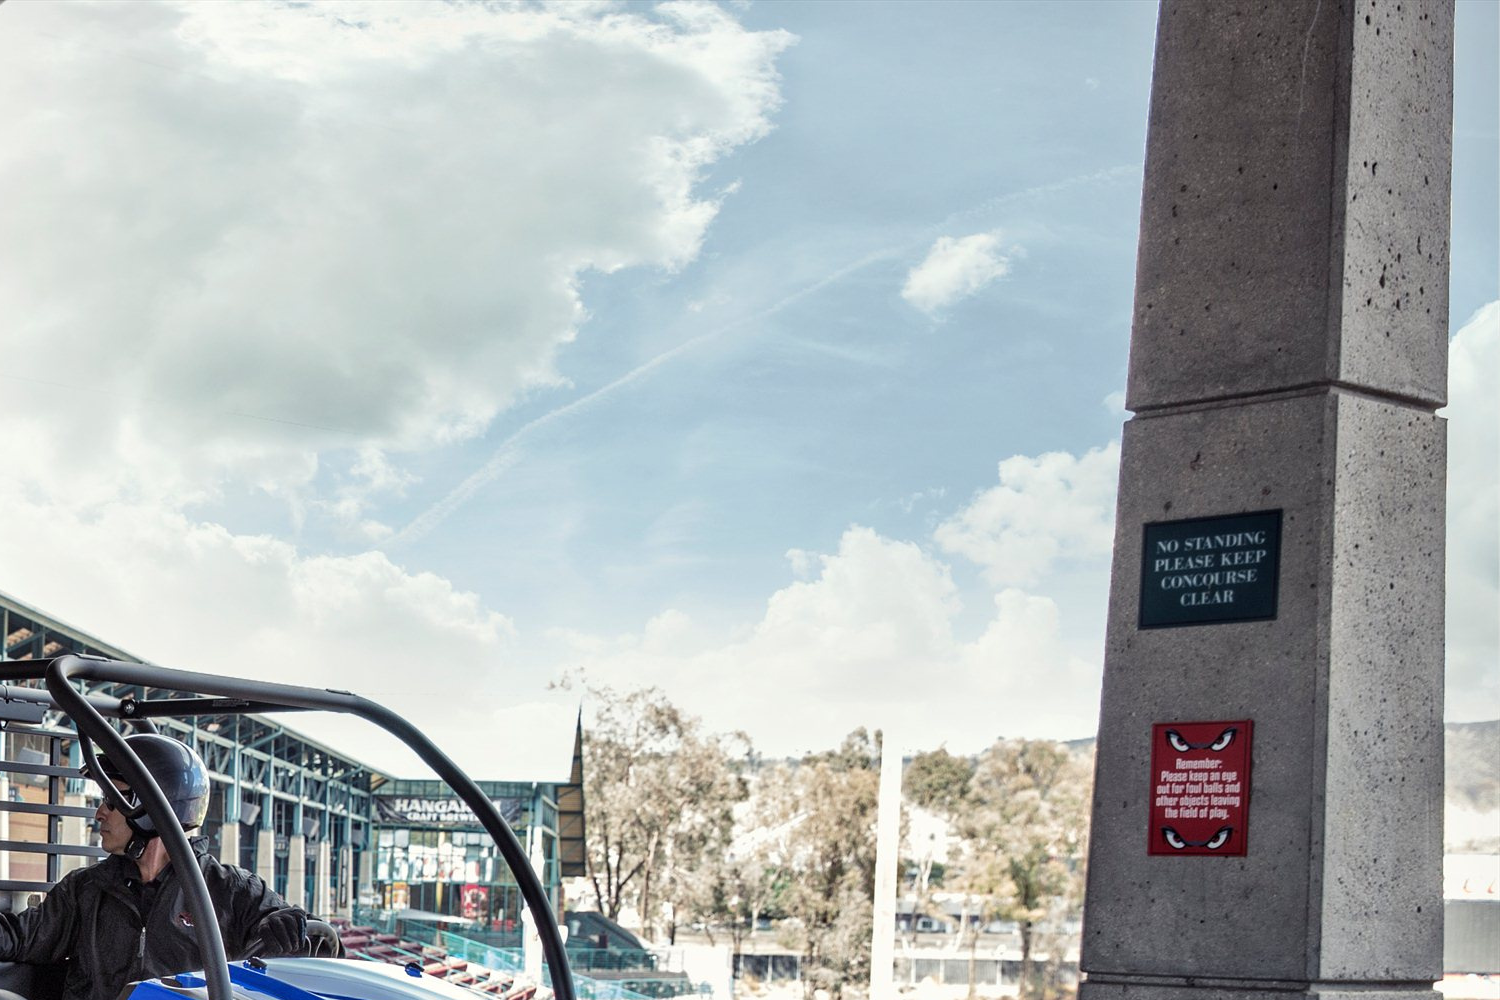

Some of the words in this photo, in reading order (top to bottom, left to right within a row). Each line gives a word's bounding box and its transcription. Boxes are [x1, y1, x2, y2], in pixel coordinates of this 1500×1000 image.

[1156, 540, 1179, 554] NO
[1184, 531, 1266, 551] STANDING
[1154, 554, 1215, 572] PLEASE
[1221, 549, 1267, 566] KEEP
[1161, 569, 1257, 589] CONCOURSE
[1180, 590, 1234, 607] CLEAR
[1175, 758, 1223, 769] Remember:
[1161, 771, 1187, 782] Please
[1189, 770, 1208, 783] keep
[1210, 772, 1220, 781] an
[1221, 771, 1237, 783] eye
[1156, 783, 1170, 794] out
[1171, 783, 1185, 794] for
[1186, 782, 1202, 793] foul
[1203, 782, 1223, 793] balls
[1225, 782, 1240, 793] and
[1156, 795, 1178, 806] other
[1179, 794, 1209, 807] objects
[1210, 794, 1240, 807] leaving
[1165, 807, 1178, 818] the
[1180, 807, 1198, 818] field
[1199, 807, 1208, 818] of
